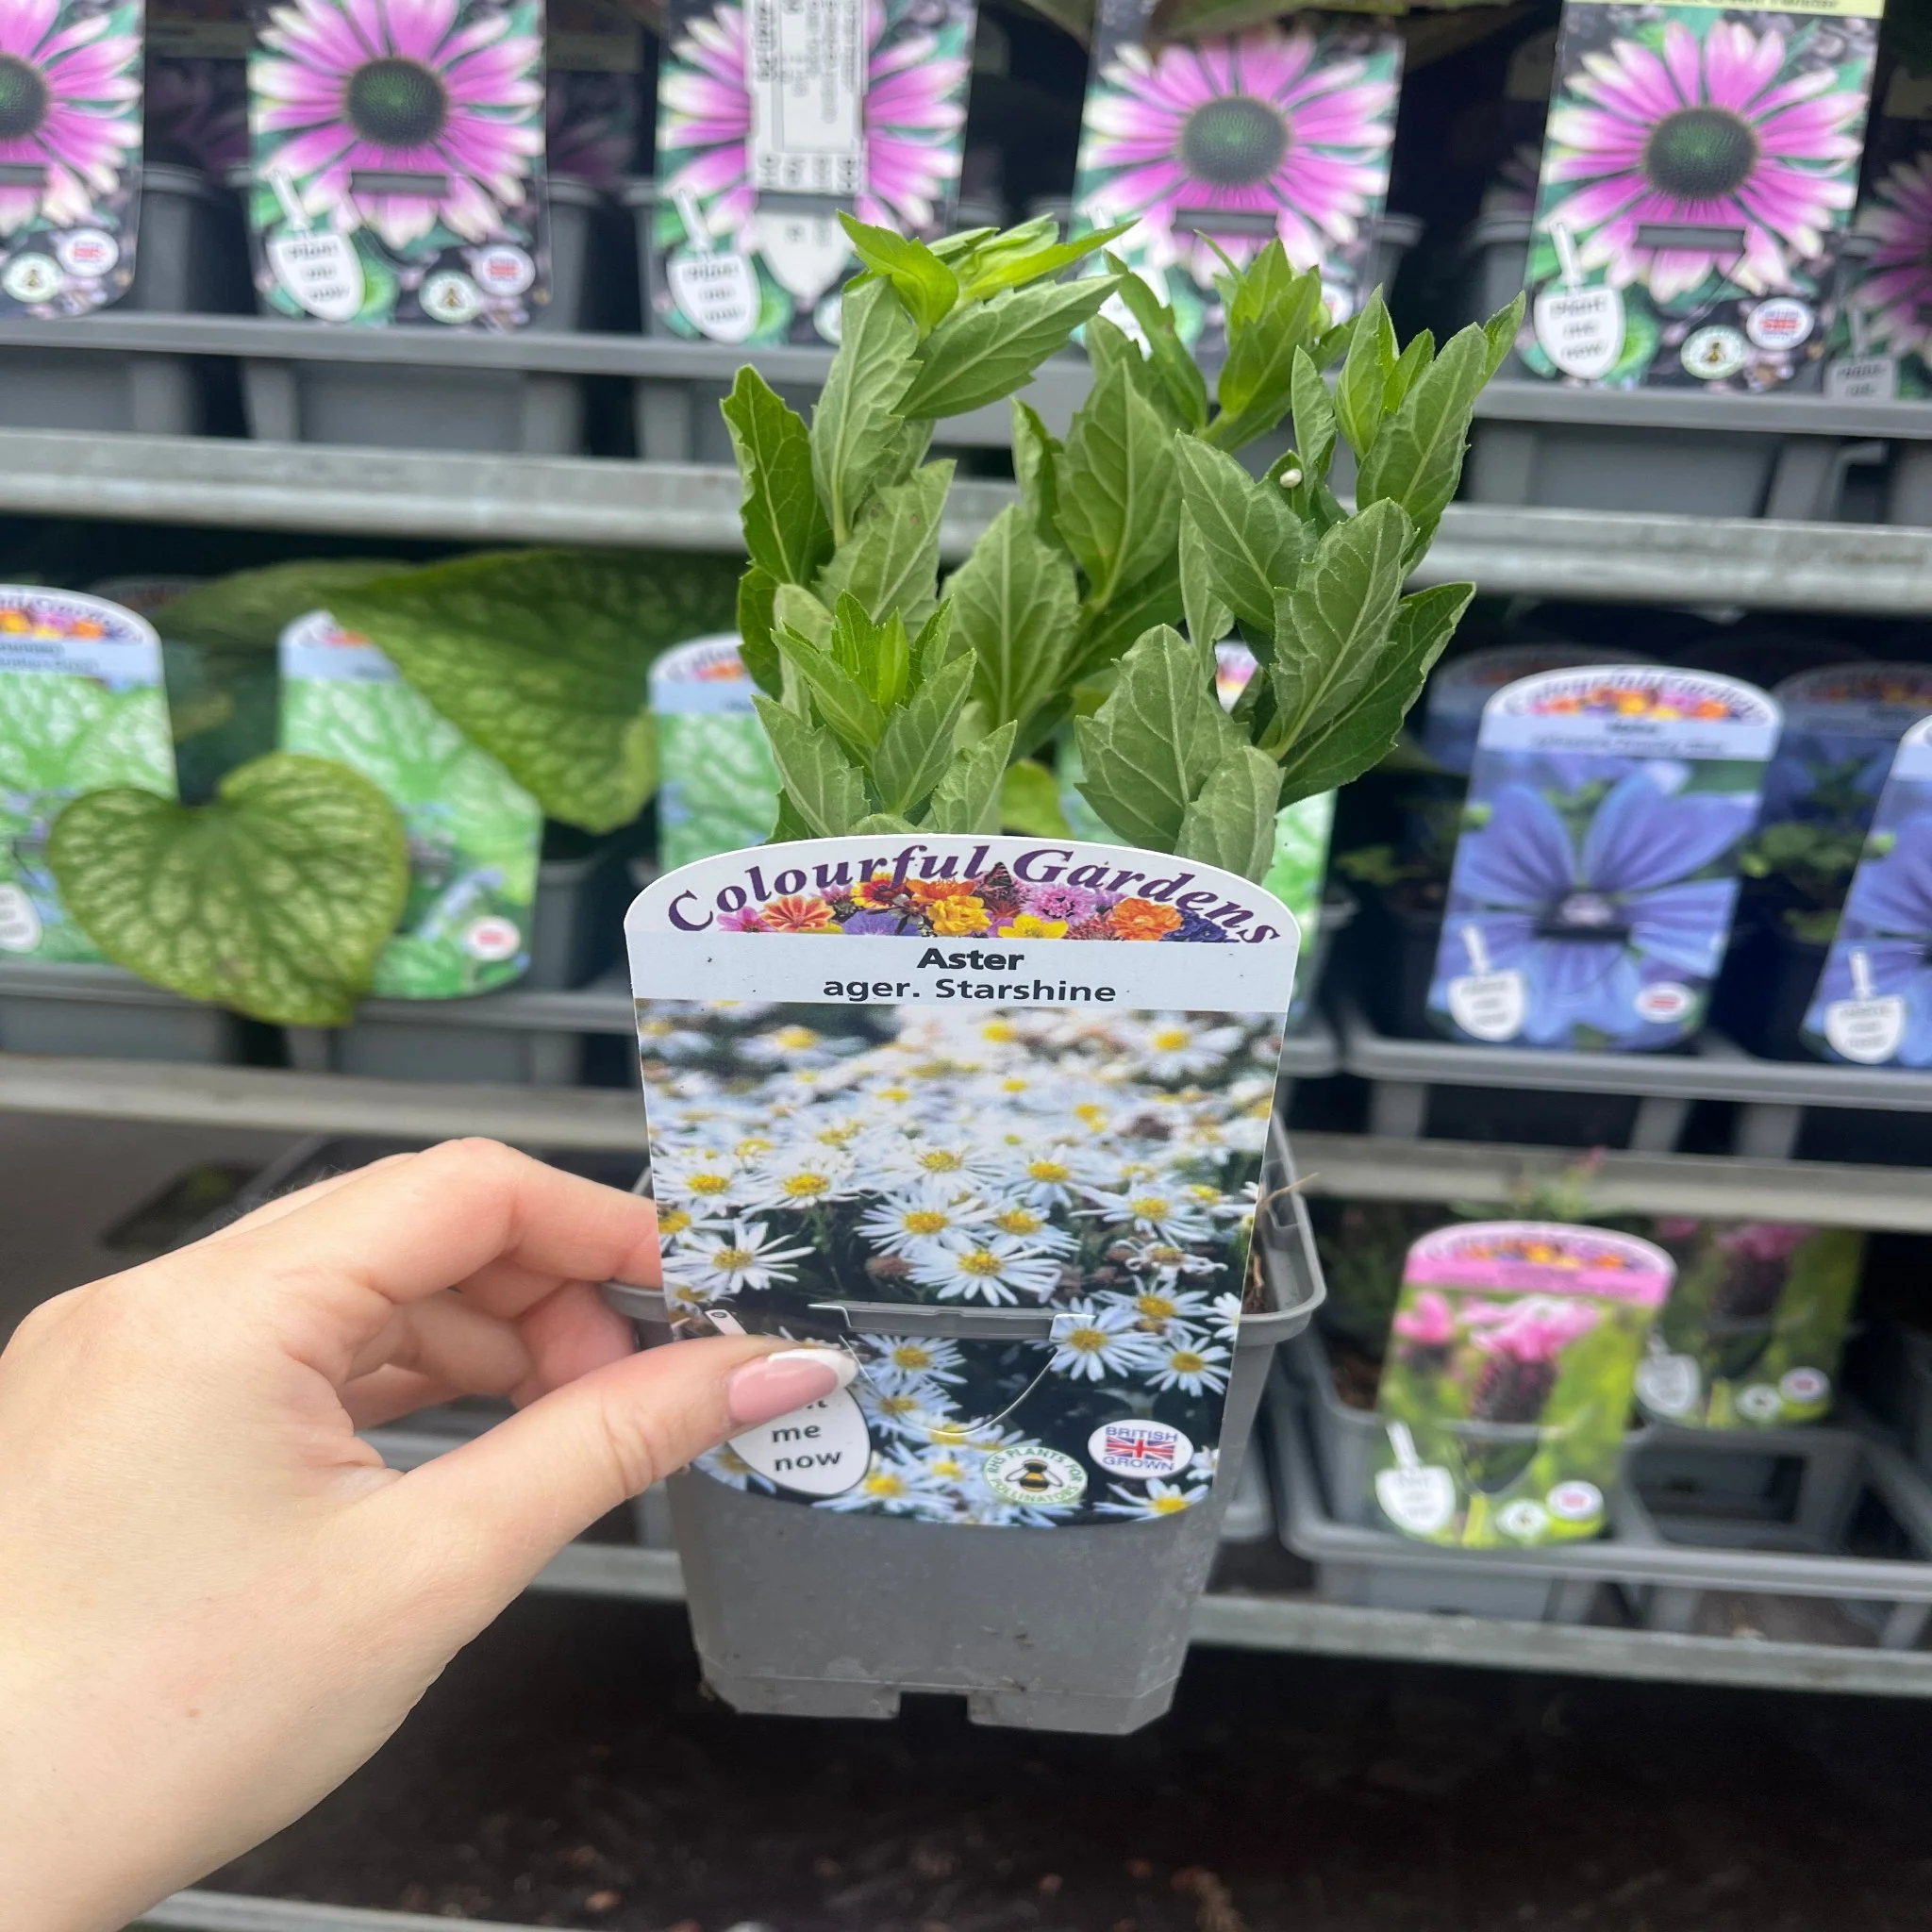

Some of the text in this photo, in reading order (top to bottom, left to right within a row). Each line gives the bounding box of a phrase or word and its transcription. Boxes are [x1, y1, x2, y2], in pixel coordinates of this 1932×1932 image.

[668, 843, 1281, 944] Colourful Gardens
[916, 947, 1025, 971] Aster
[823, 978, 1117, 1003] ager. Starshine
[771, 1424, 822, 1443] me
[1105, 1425, 1178, 1443] BRITISH
[774, 1451, 843, 1472] now
[988, 1447, 1084, 1483] RHS PLANTS FOR
[1103, 1455, 1175, 1472] GROWN
[992, 1478, 1082, 1504] POLLINATORS
